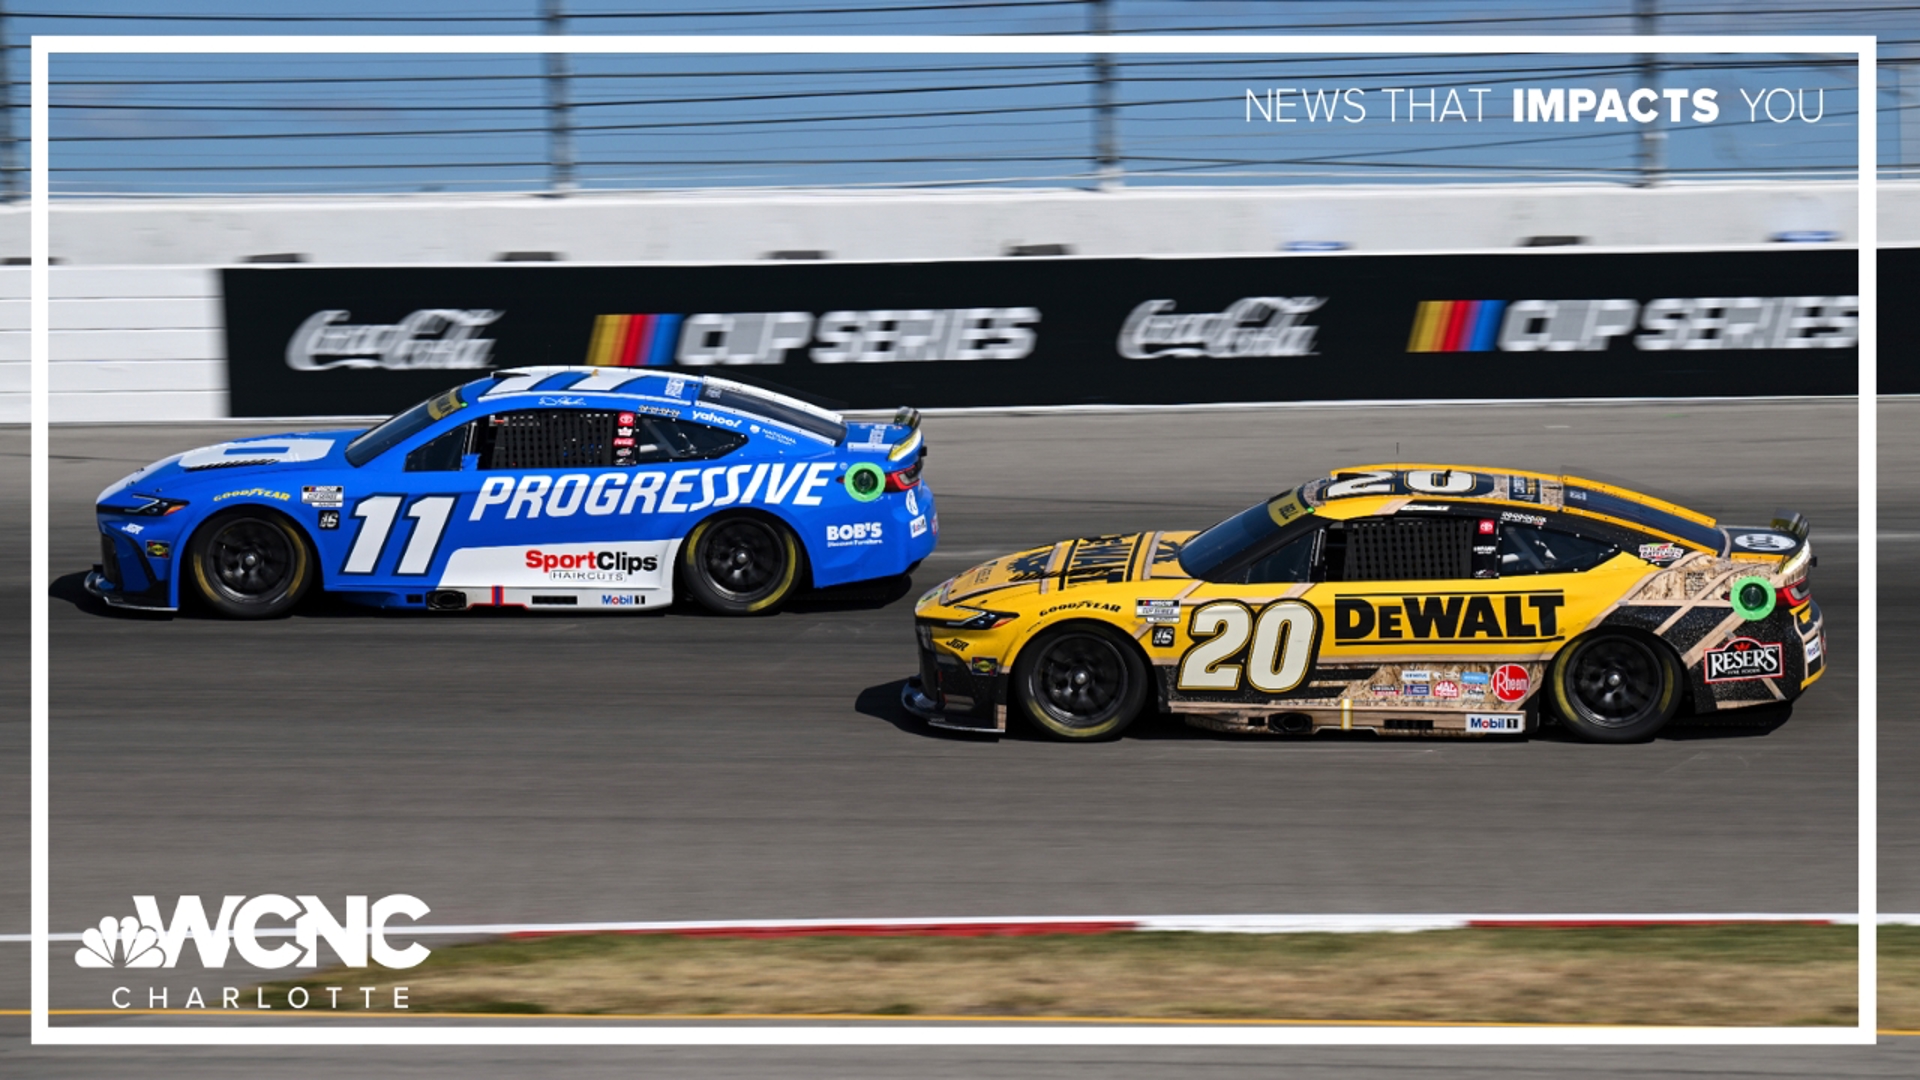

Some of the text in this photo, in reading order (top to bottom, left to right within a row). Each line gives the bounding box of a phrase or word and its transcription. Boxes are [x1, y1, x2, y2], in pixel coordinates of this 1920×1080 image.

[1499, 296, 1858, 352] CUP SERIES
[676, 307, 1041, 366] CUP SERIES
[692, 410, 743, 428] yahoo!
[213, 487, 291, 502] GOODYEAR
[468, 462, 838, 521] PROGRESSIVE
[343, 495, 456, 575] 11
[827, 522, 882, 541] BOB'S
[553, 572, 624, 582] HAIRCUTS
[602, 594, 633, 605] Mobil
[1039, 600, 1121, 617] GOODYEAR
[1177, 600, 1318, 692] 20
[1495, 665, 1528, 697] Rheem
[1470, 718, 1505, 729] Mobil
